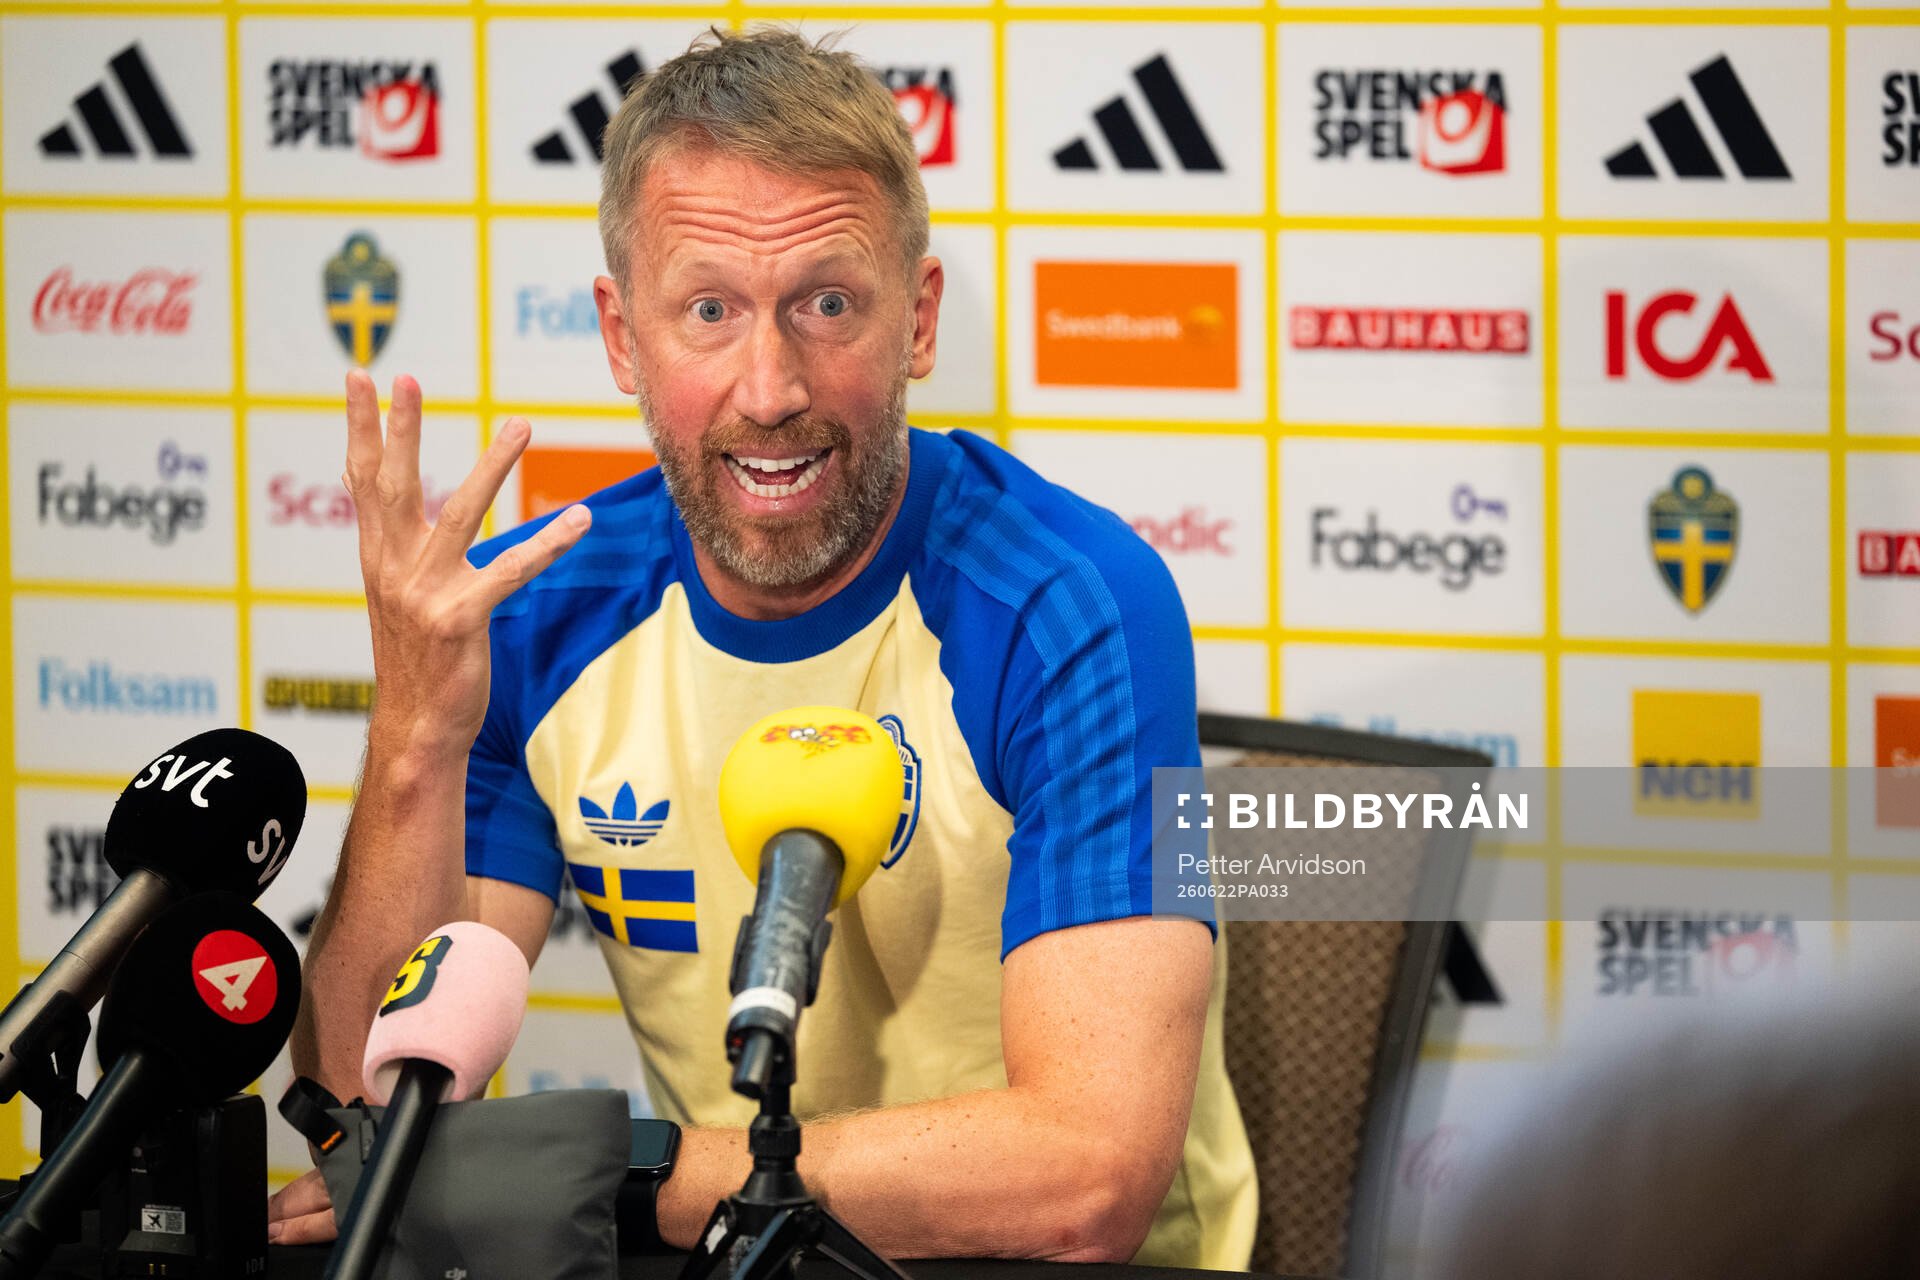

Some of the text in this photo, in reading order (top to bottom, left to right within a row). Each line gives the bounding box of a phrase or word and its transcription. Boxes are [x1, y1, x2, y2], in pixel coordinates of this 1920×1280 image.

[1314, 69, 1508, 112] SVENSKA
[269, 107, 355, 148] SPEL
[1314, 119, 1411, 159] SPEL
[1290, 307, 1529, 353] BAUHAUS
[1605, 290, 1776, 384] ICA
[37, 464, 207, 546] Fabege
[1311, 507, 1506, 591] Fabege
[38, 658, 217, 714] Folksam
[134, 754, 235, 808] svt
[199, 956, 268, 1011] 4
